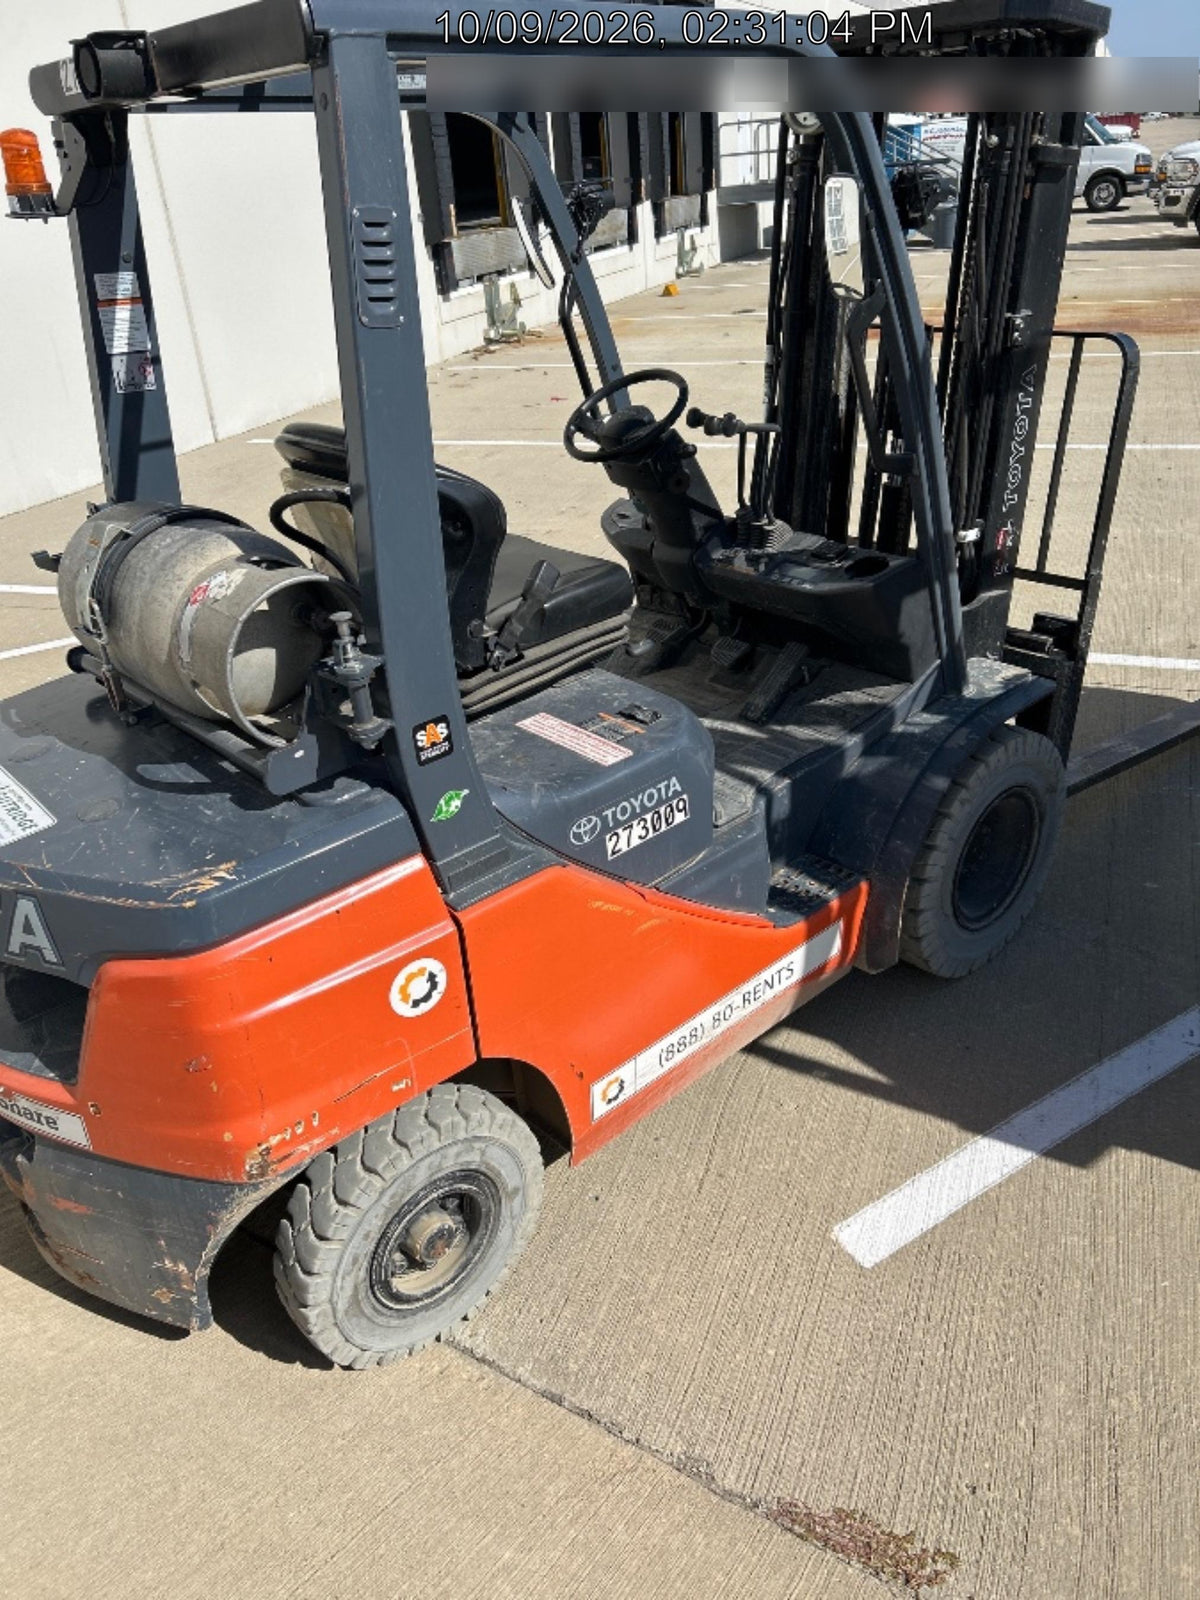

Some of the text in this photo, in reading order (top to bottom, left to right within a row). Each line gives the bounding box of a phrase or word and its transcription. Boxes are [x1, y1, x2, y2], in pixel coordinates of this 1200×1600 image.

[1002, 363, 1038, 512] TOYOTA
[415, 722, 449, 749] SAS
[602, 776, 682, 828] TOYOTA
[608, 797, 688, 857] 273009
[657, 960, 796, 1069] (888) 80-RENTS
